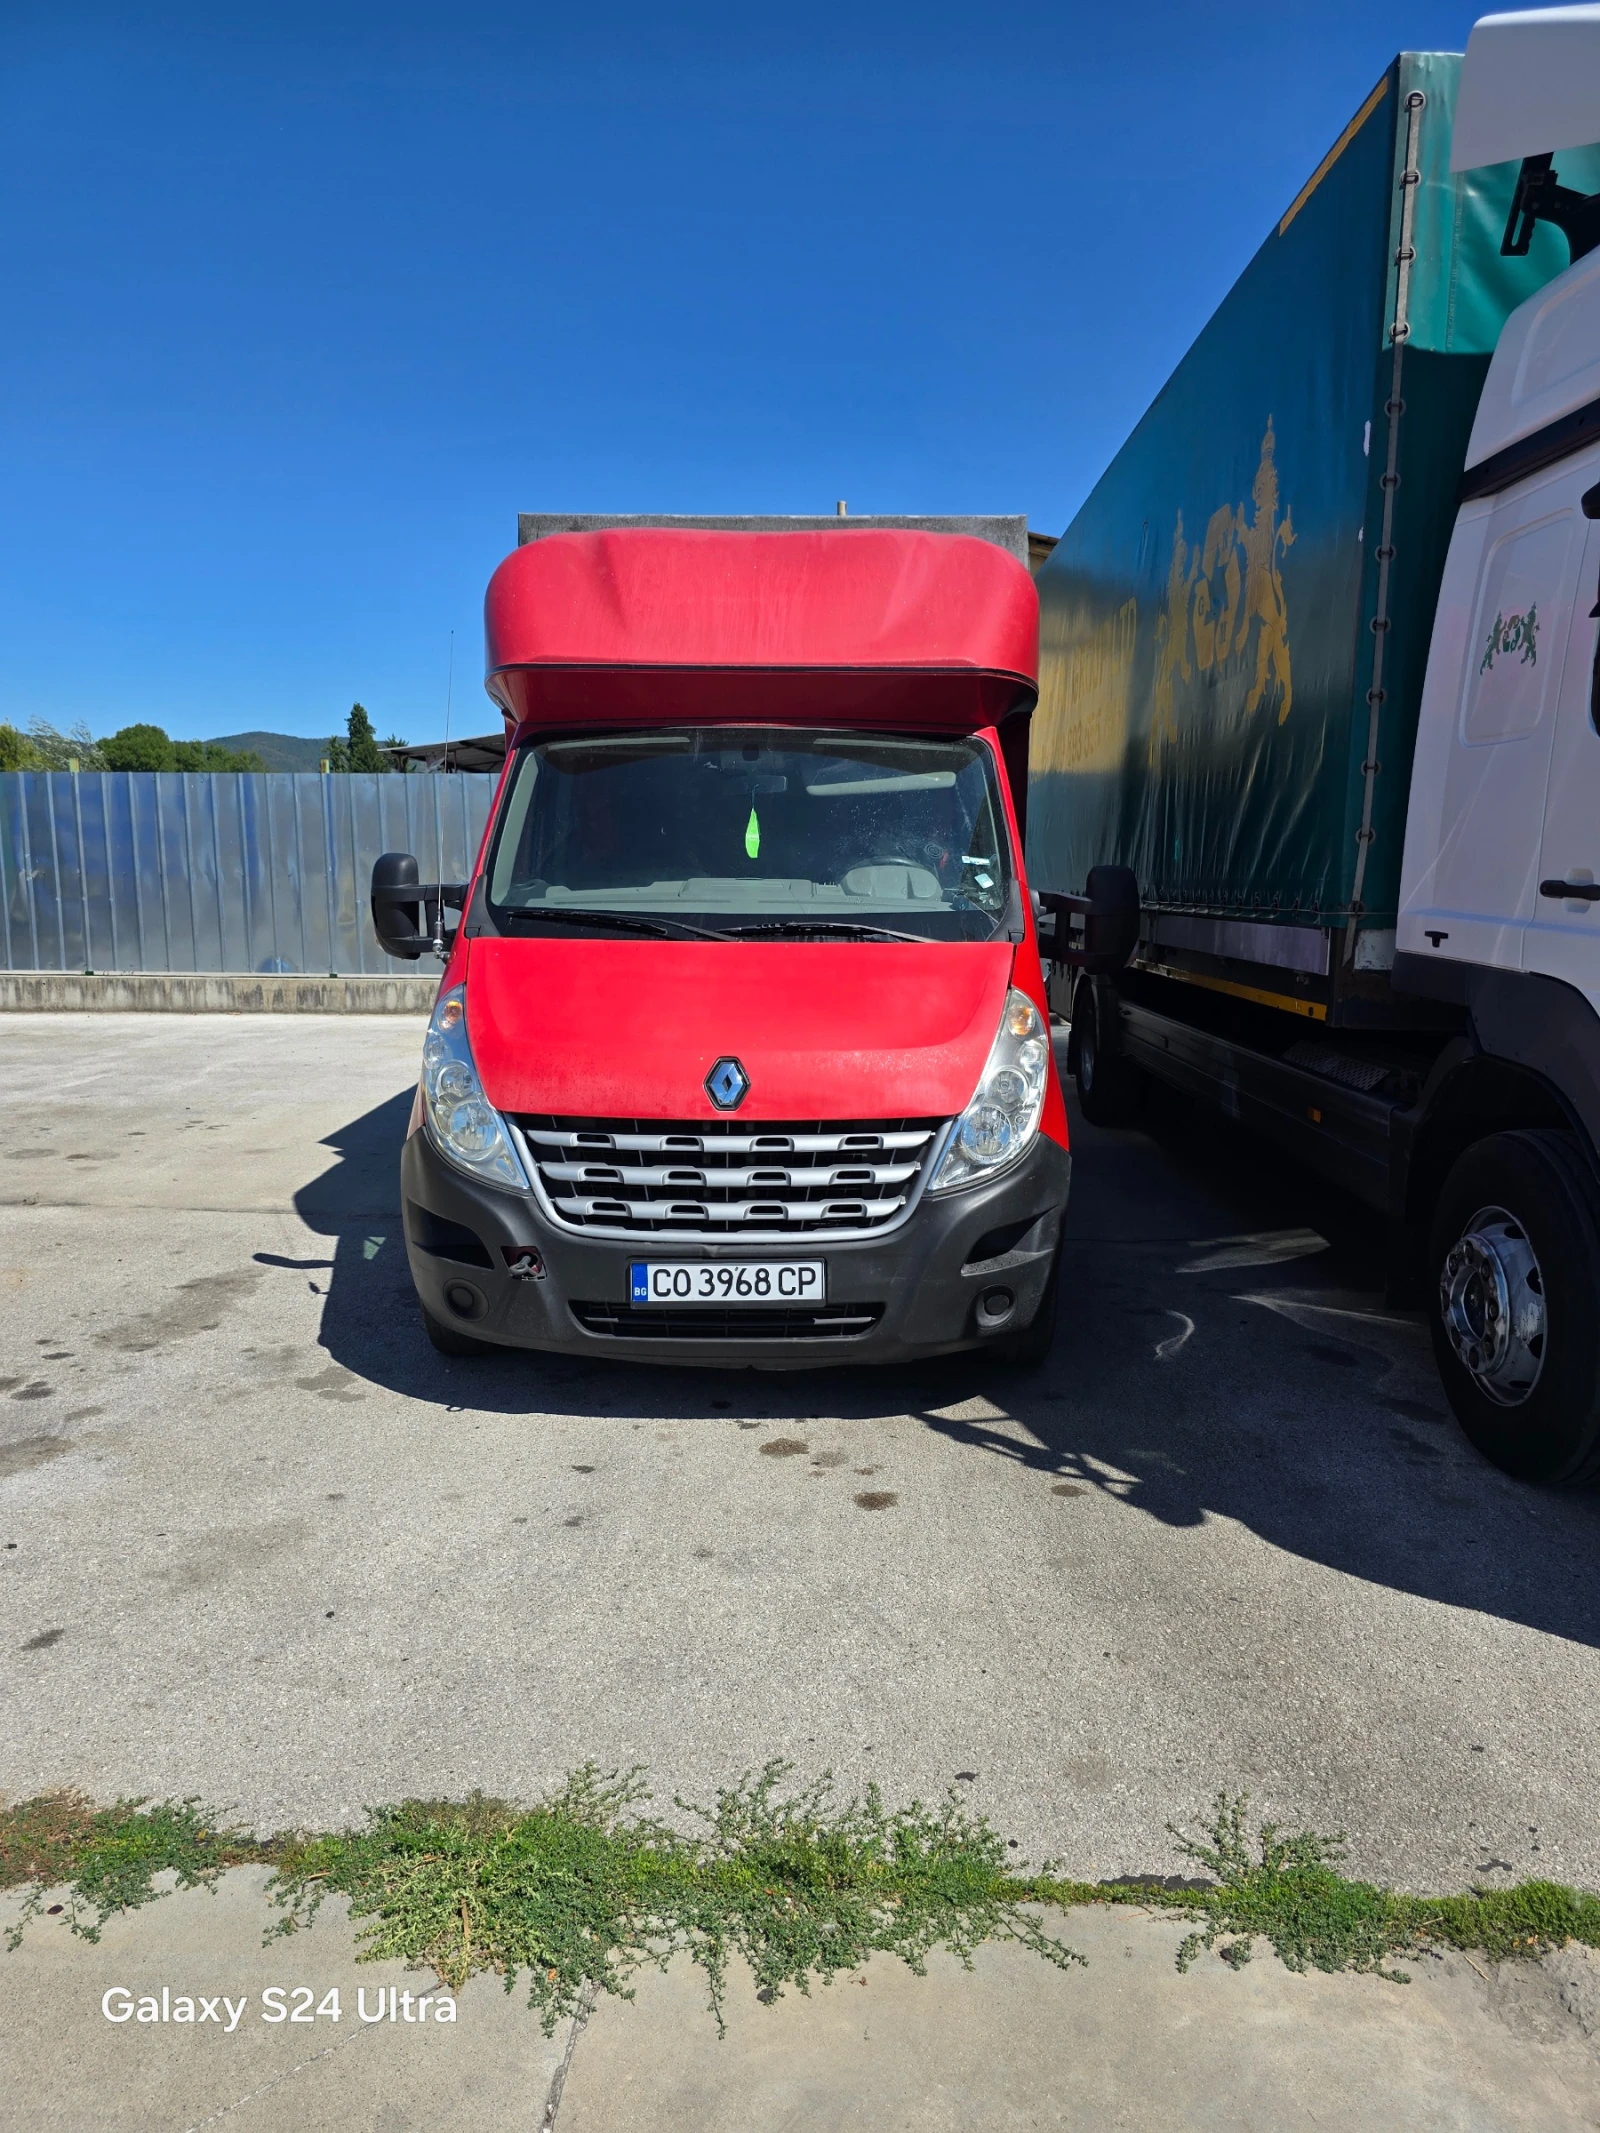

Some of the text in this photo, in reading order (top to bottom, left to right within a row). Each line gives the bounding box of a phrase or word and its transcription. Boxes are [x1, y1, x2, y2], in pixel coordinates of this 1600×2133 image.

[634, 1287, 647, 1296] BG
[653, 1267, 816, 1297] CO 3968 CP
